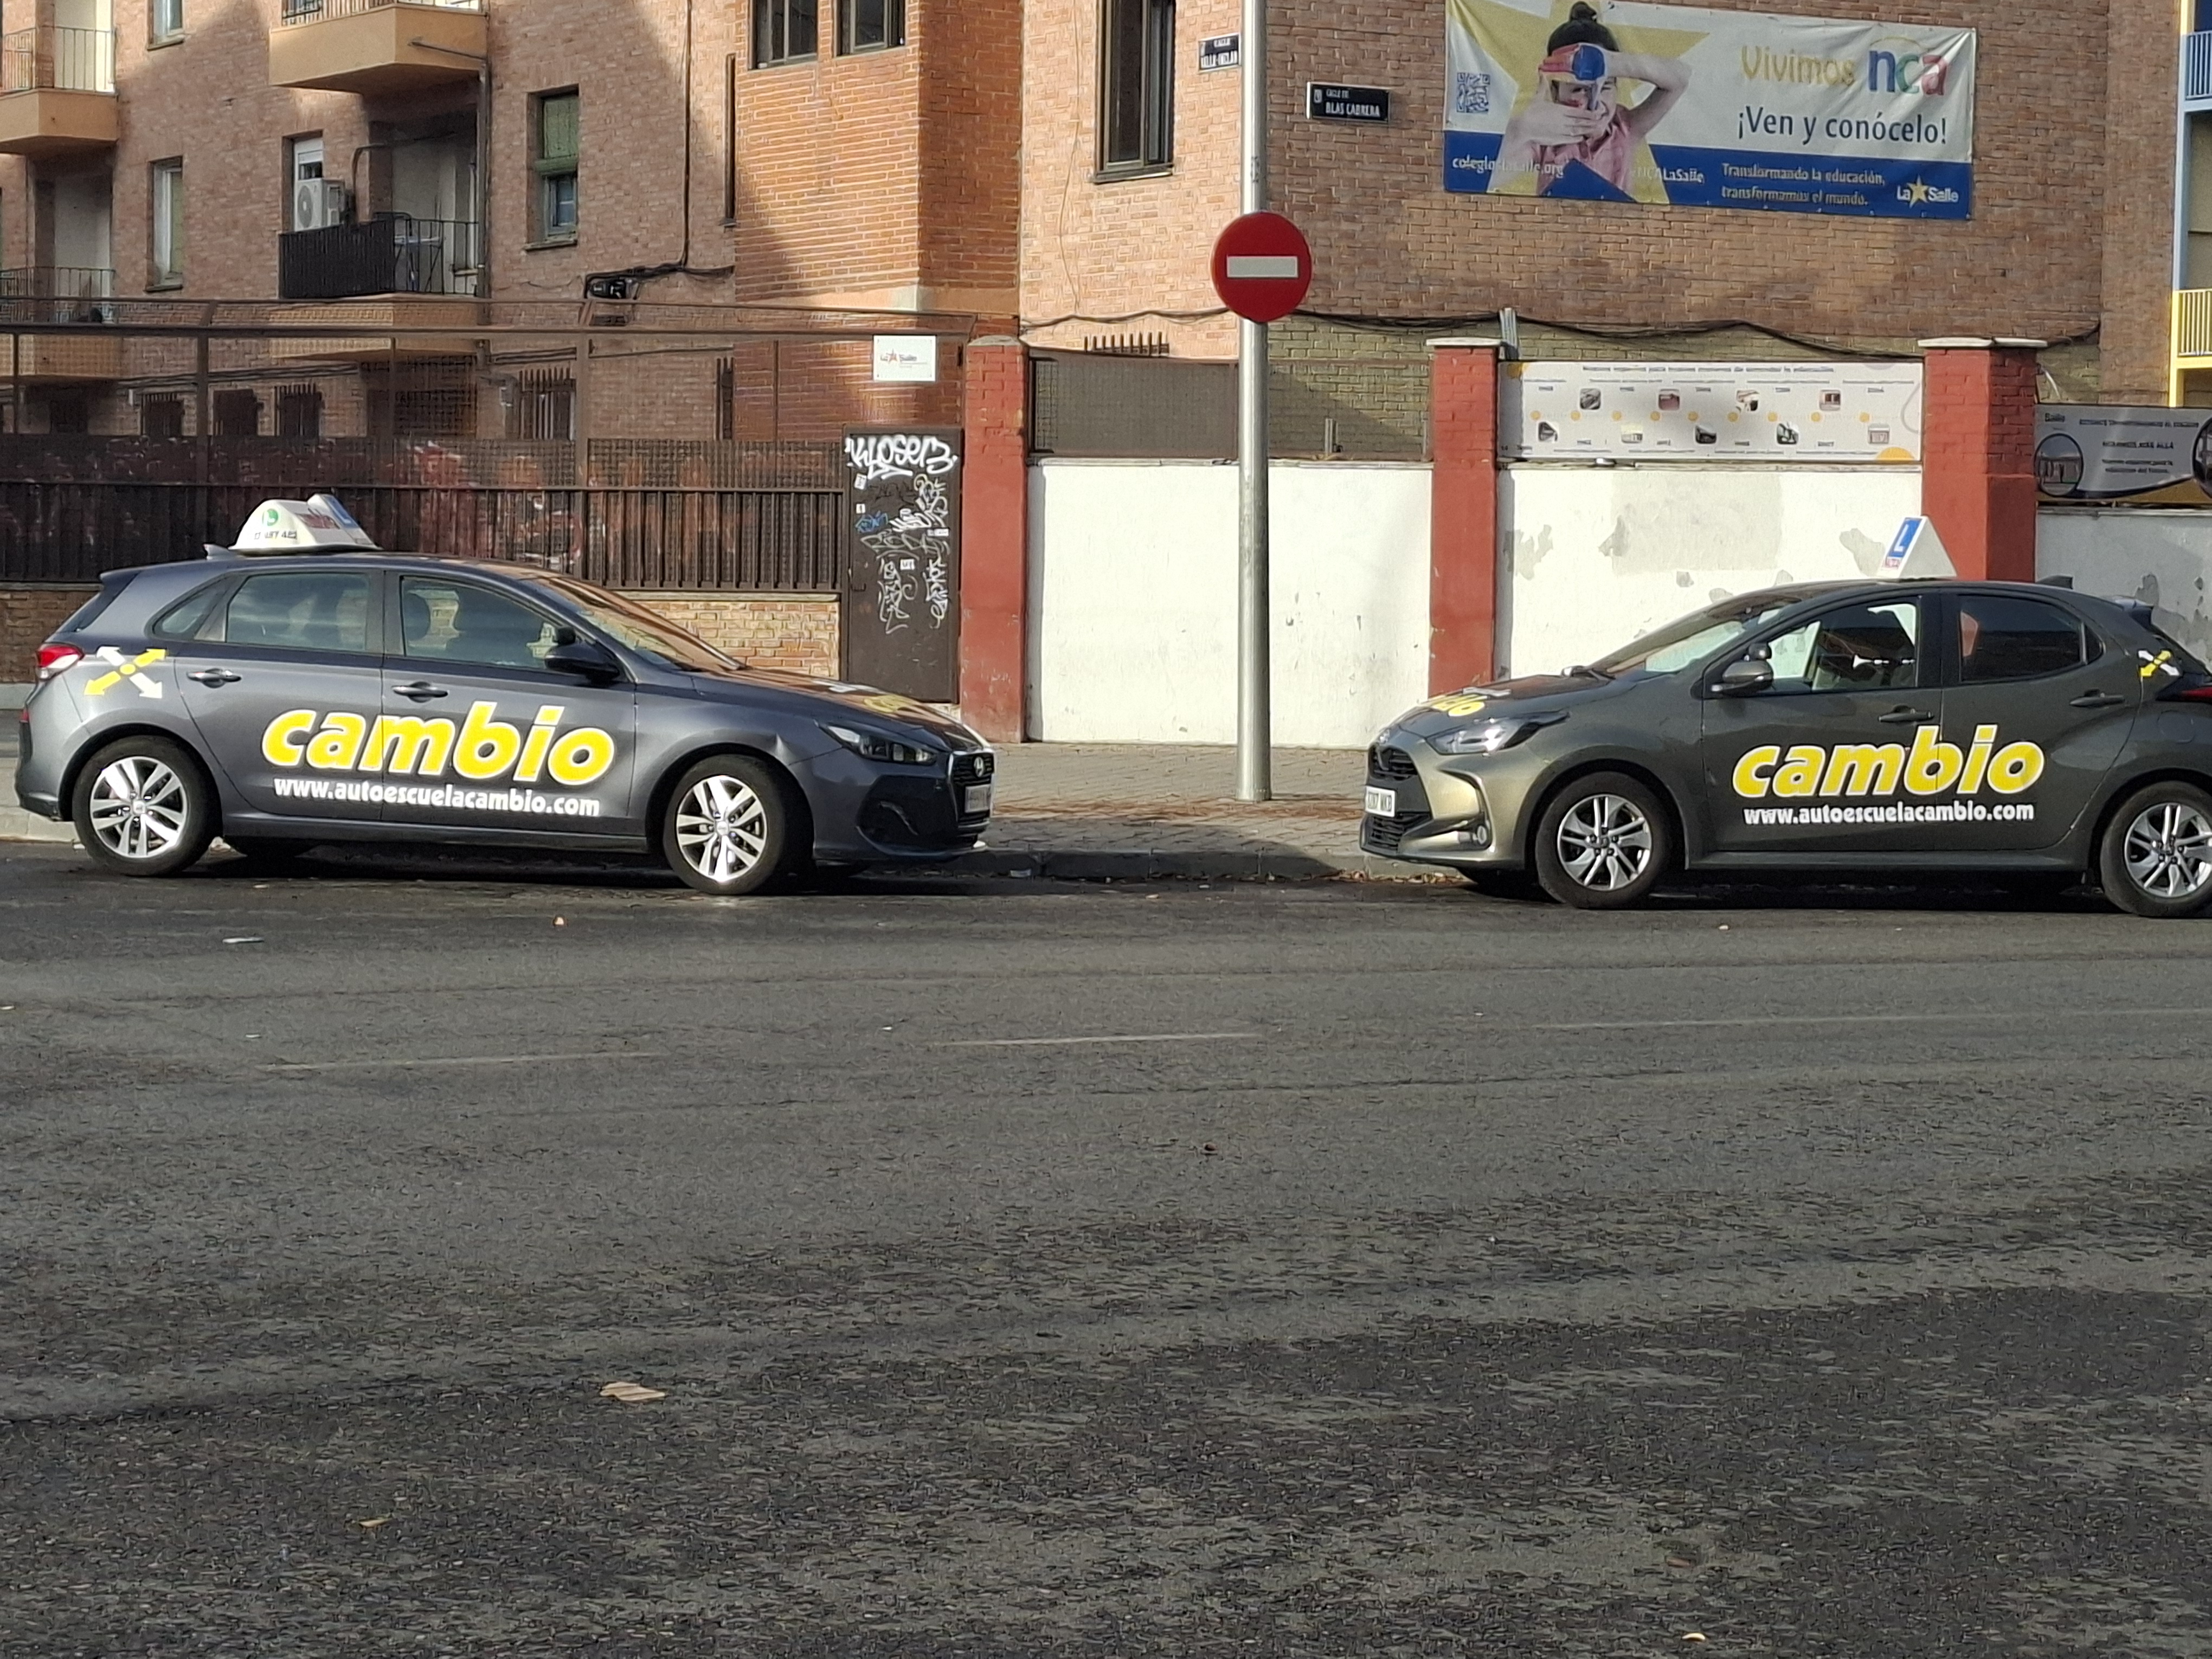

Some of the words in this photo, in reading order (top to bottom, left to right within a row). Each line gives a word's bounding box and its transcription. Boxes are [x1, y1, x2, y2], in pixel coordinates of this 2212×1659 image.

[1741, 46, 1856, 86] Vivimos
[1868, 49, 1949, 95] nca
[1326, 101, 1344, 114] BLAS
[1346, 102, 1380, 117] CABRERA
[1739, 106, 1793, 139] ¡Ven
[1803, 116, 1816, 145] y
[1825, 112, 1946, 144] conócelo!
[1722, 163, 1809, 181] Transformando
[1812, 168, 1822, 180] la
[1812, 190, 1822, 203] el
[1825, 191, 1868, 205] mundo.
[1897, 185, 1911, 202] La
[1928, 187, 1959, 202] Salle
[261, 701, 615, 786] cambio
[1732, 724, 2045, 798] cambio
[274, 778, 600, 816] www.autoescuelacambio.com
[1744, 800, 2035, 825] www.autoescuelacambio.com
